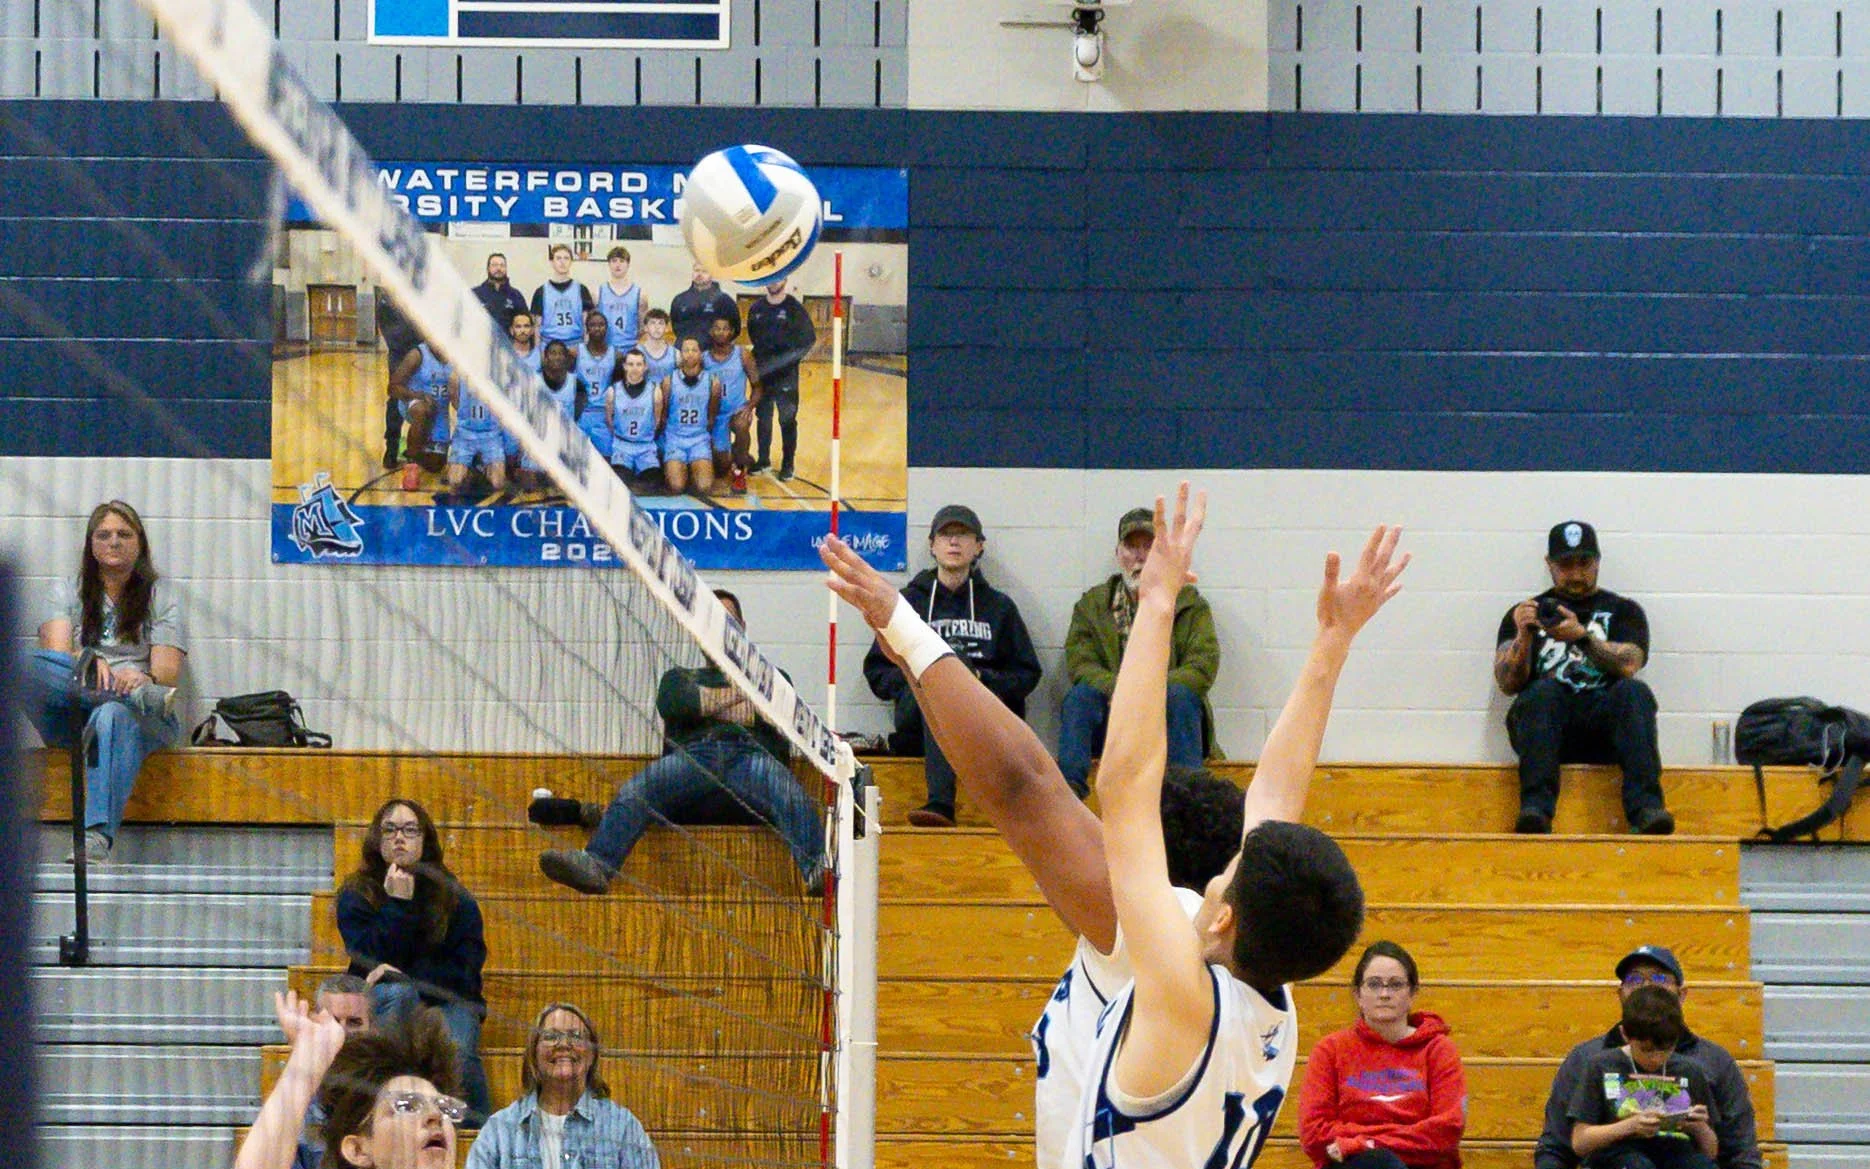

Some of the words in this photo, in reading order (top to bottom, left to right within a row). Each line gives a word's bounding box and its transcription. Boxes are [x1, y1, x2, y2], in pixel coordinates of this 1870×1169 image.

[377, 169, 648, 193] WATERFORD
[557, 312, 573, 326] 35
[615, 316, 624, 330] 4
[680, 409, 699, 424] 22
[630, 421, 638, 435] 2
[426, 508, 495, 538] LVC
[511, 508, 753, 541] CHAIONS
[541, 542, 614, 561] 202
